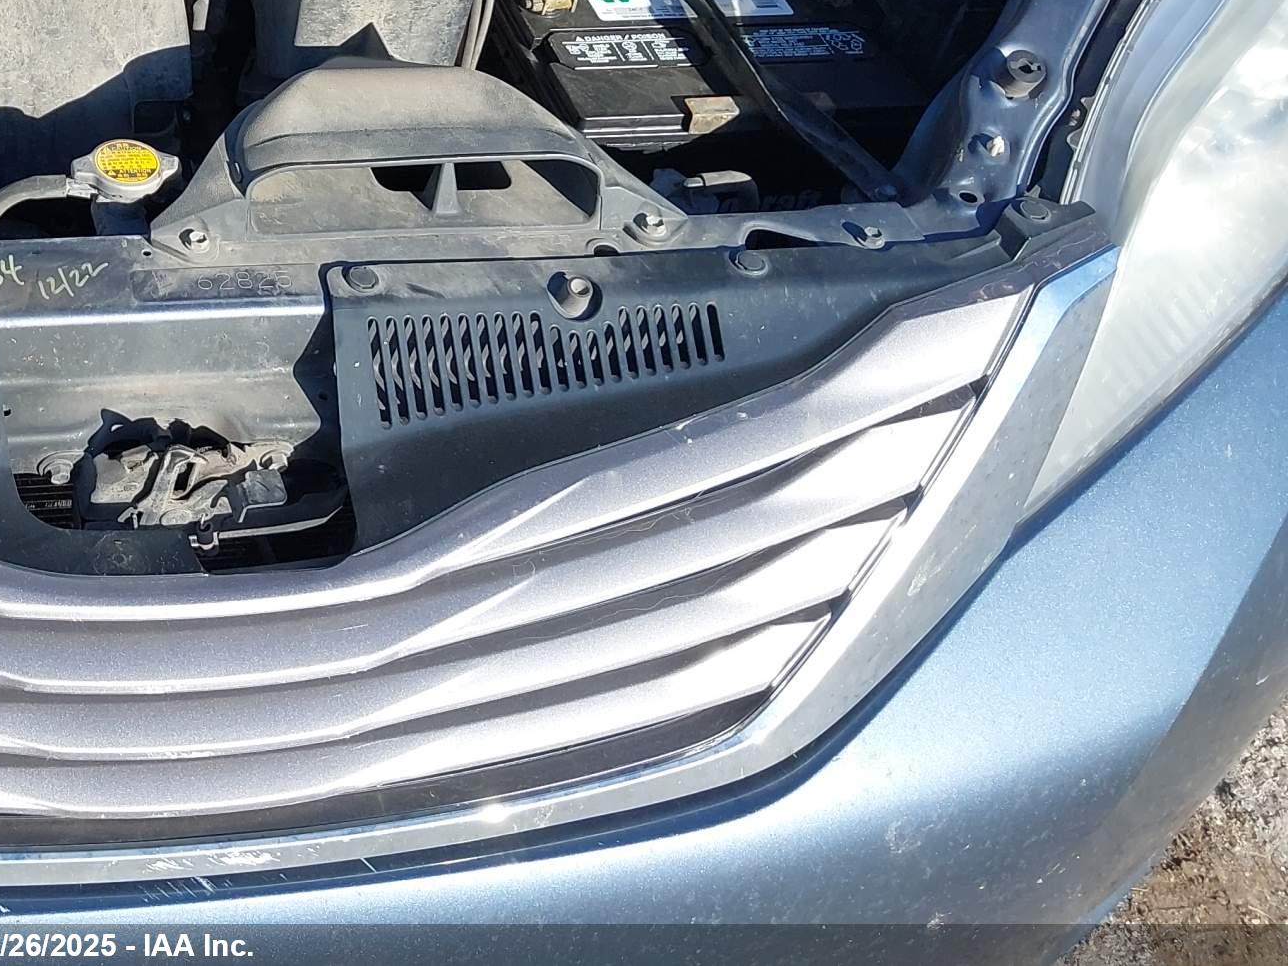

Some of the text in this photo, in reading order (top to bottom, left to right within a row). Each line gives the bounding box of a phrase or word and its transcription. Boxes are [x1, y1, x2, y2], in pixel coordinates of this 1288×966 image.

[584, 34, 623, 42] DANGER
[630, 32, 666, 40] POISON
[197, 270, 293, 297] 62825
